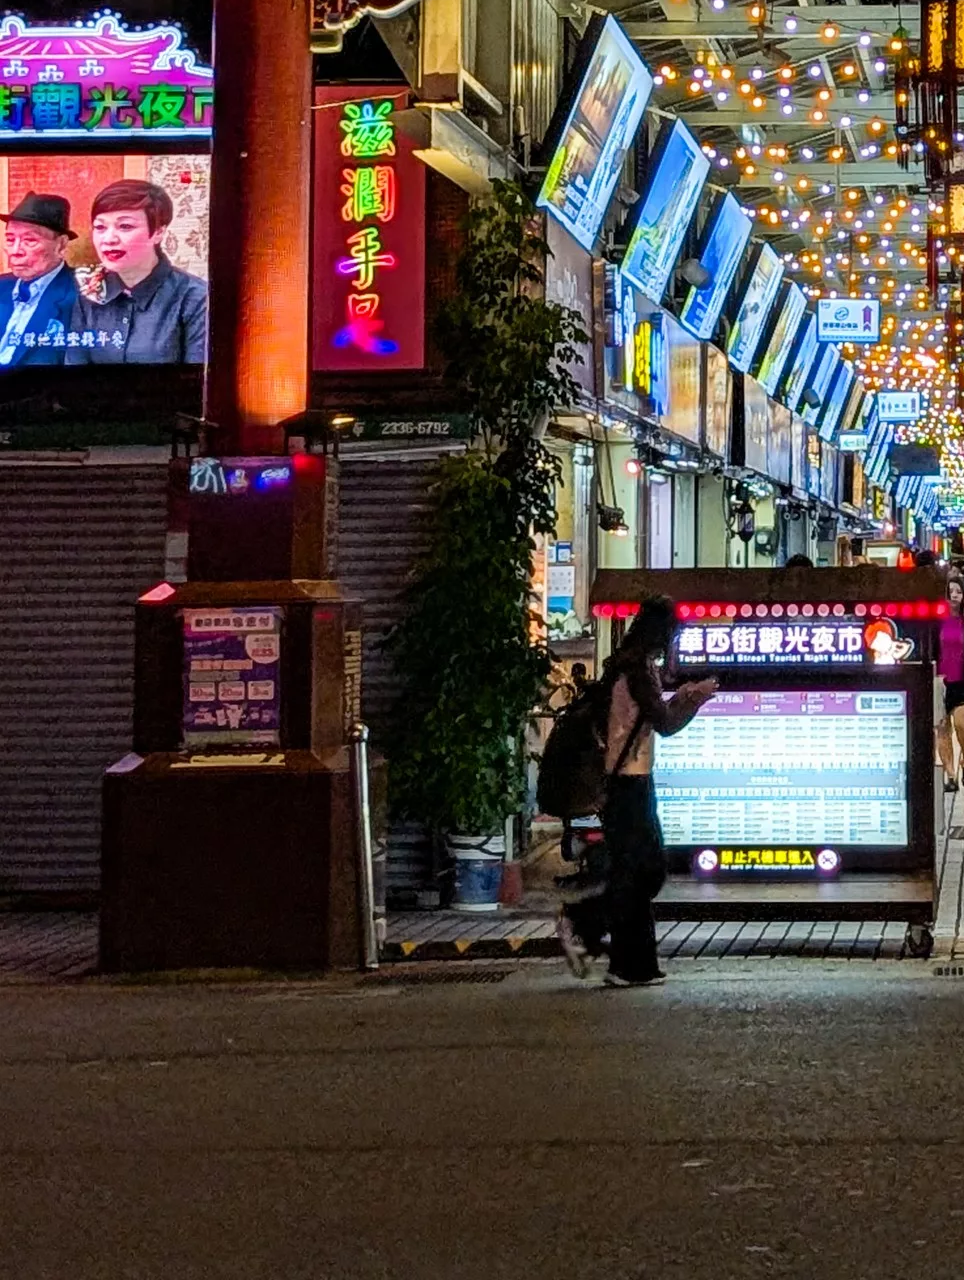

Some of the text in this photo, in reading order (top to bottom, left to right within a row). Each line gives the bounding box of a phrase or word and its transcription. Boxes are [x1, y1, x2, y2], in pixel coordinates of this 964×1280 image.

[381, 422, 450, 435] 2336-6792
[678, 627, 863, 654] 華西街觀光夜市
